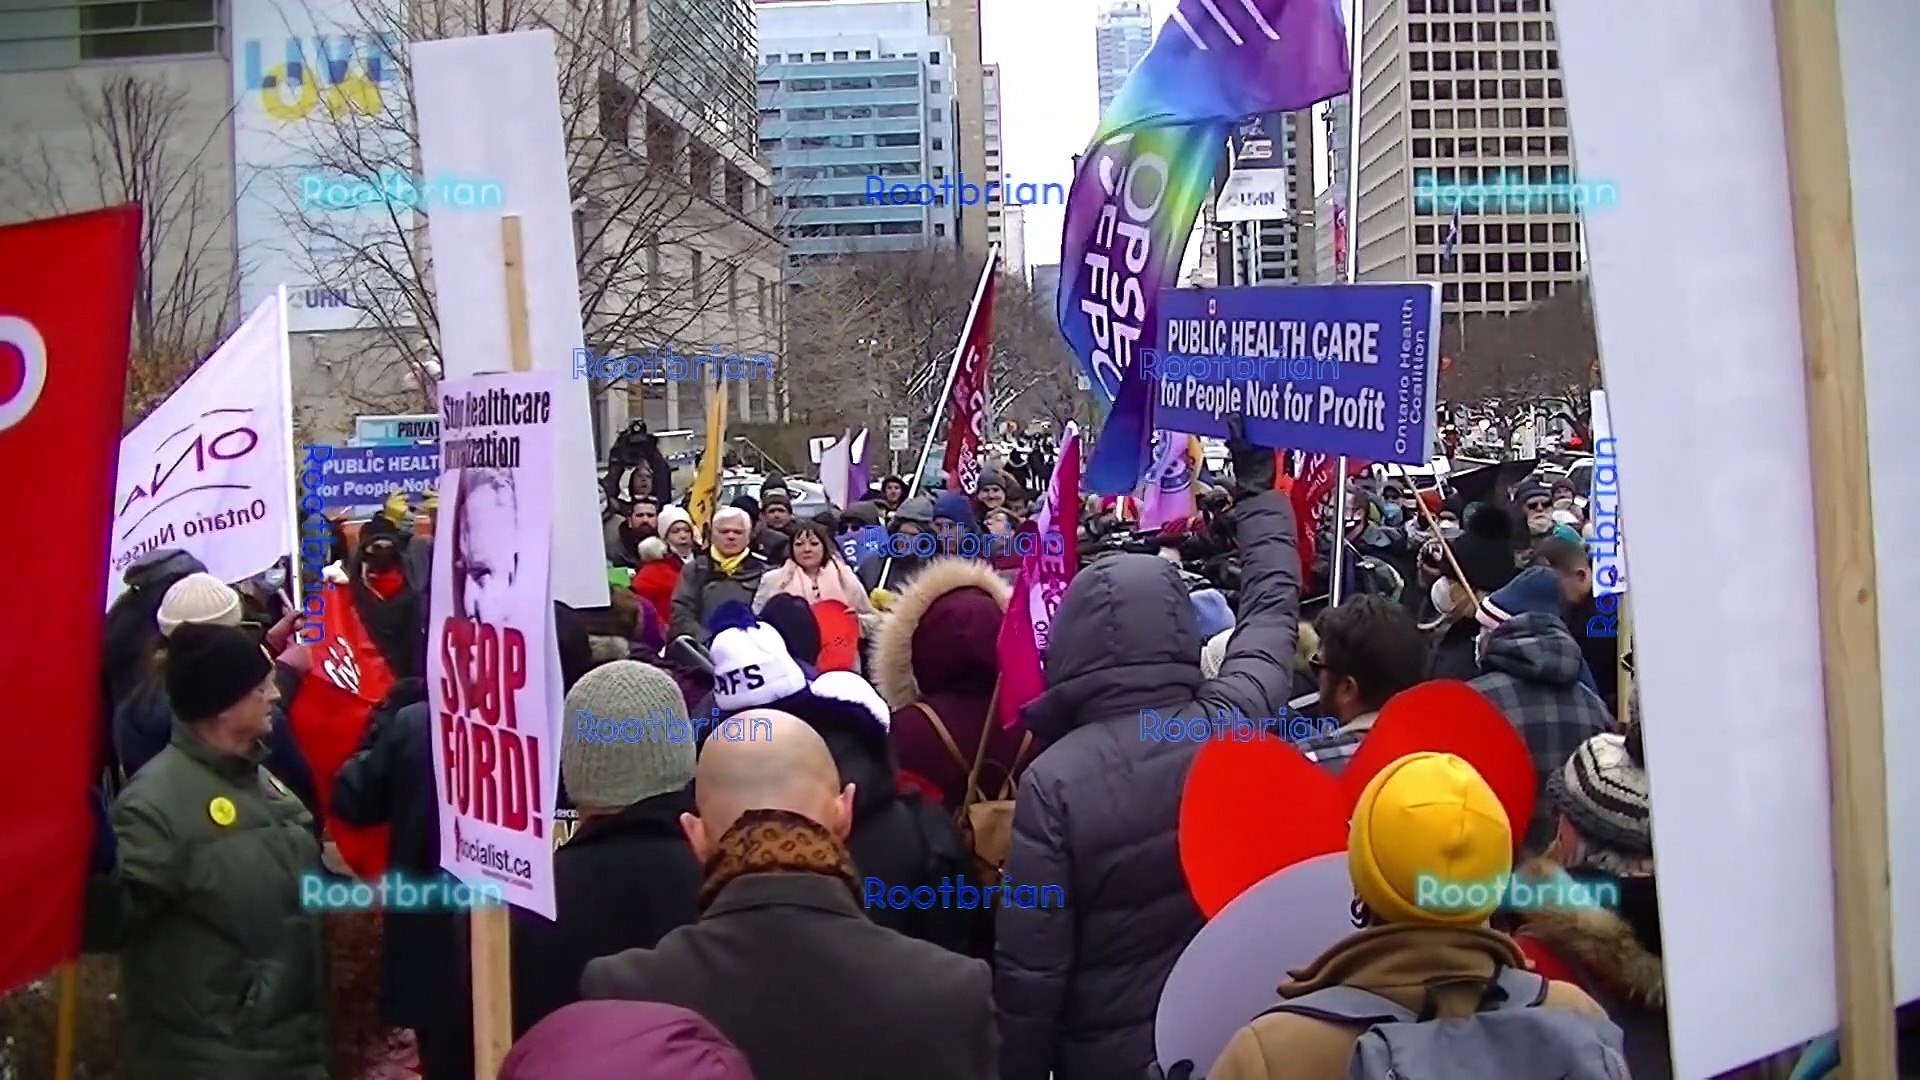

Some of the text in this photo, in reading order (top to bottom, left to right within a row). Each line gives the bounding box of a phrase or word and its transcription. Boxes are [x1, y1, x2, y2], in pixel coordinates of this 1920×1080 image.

[1167, 319, 1381, 364] PUBLIC HEALTH CARE
[1160, 373, 1386, 433] for People Not for Profit
[1394, 299, 1414, 454] Ontario Health
[1408, 330, 1425, 424] Coalition
[397, 421, 440, 438] PRIVAT
[322, 454, 440, 474] PUBLIC HEALT
[440, 616, 526, 729] STOP
[714, 664, 765, 695] AFS
[440, 711, 543, 839] FORD!
